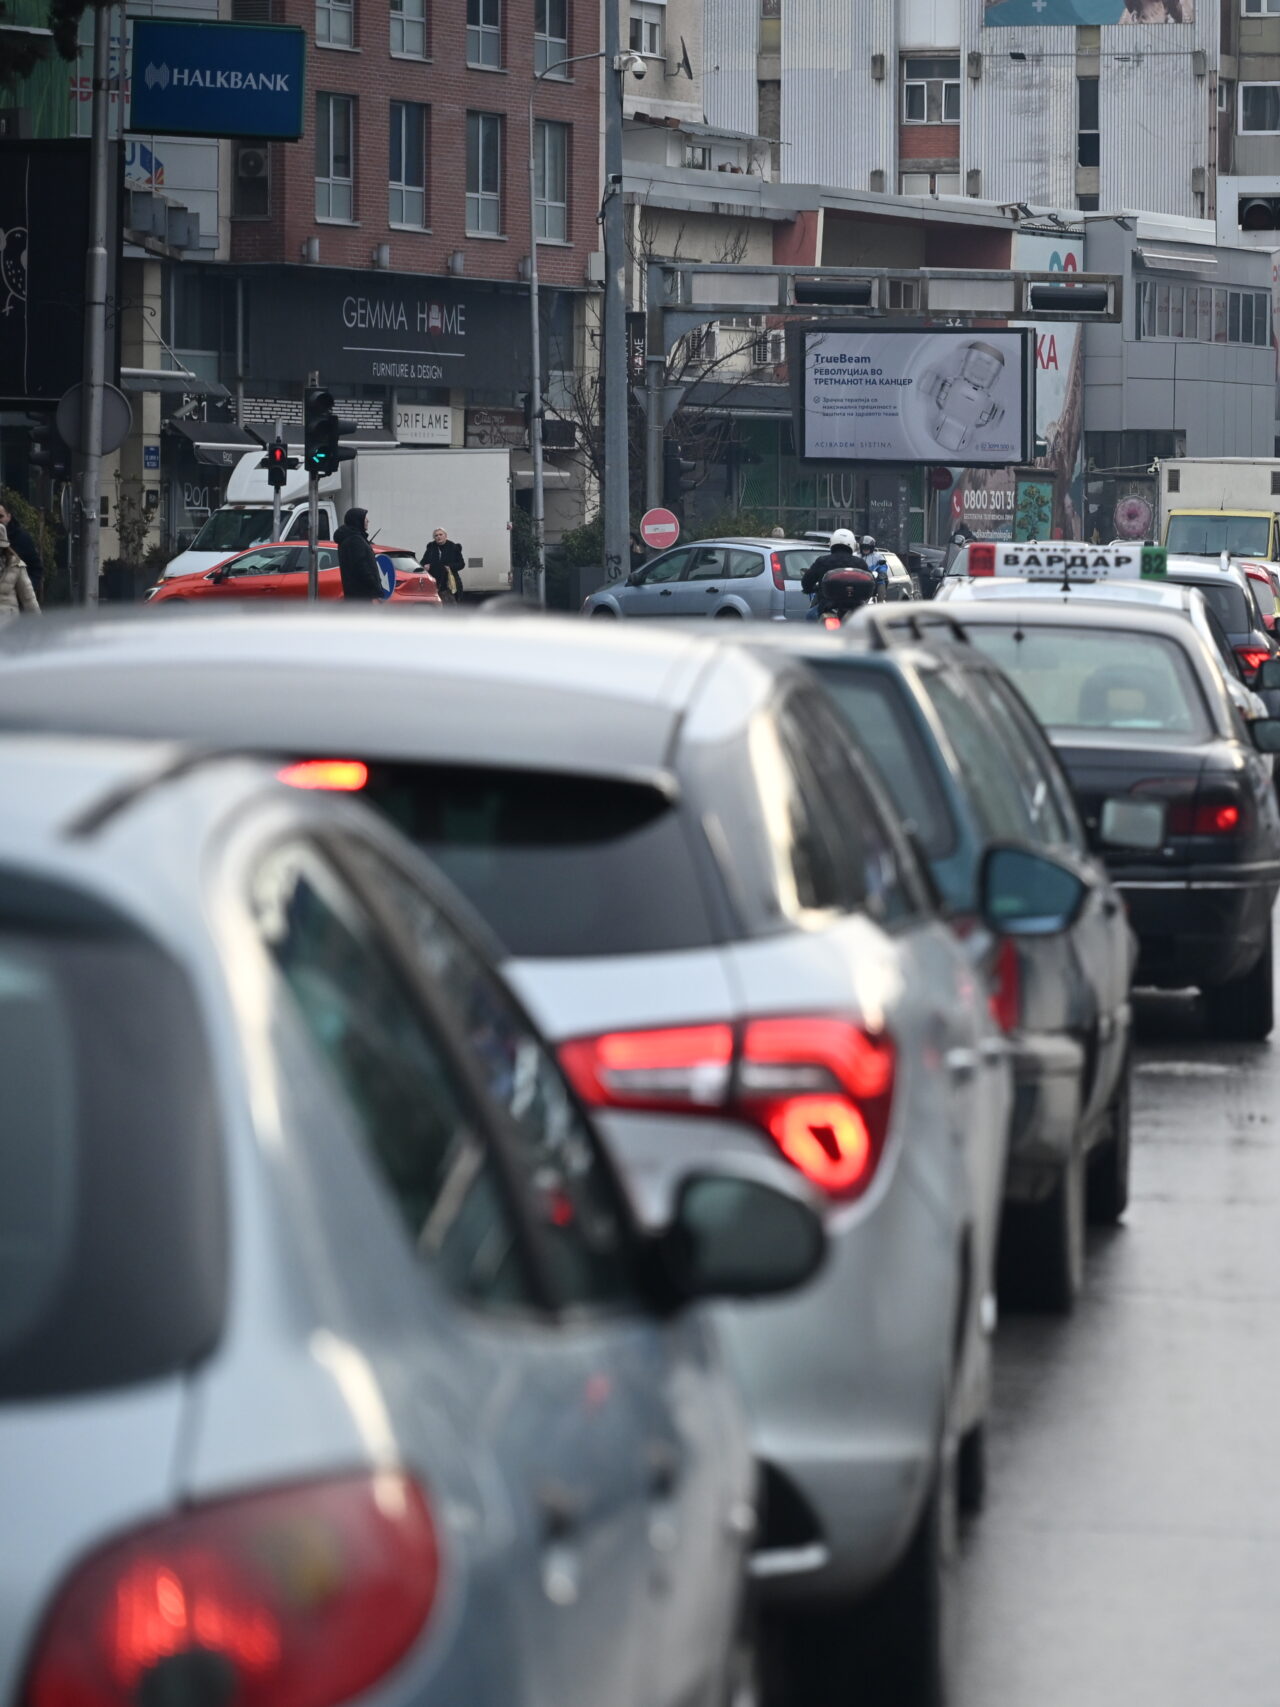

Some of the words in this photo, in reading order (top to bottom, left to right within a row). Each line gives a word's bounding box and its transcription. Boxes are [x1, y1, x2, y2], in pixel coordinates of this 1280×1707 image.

[173, 68, 289, 91] HALKBANK
[343, 296, 408, 331] GEMMA
[814, 353, 871, 364] TrueBeam
[372, 362, 409, 378] FURNITURE
[410, 365, 416, 378] &
[417, 364, 443, 379] DESIGN
[814, 368, 869, 377] РЕВОЛУЦИЈА
[870, 368, 883, 376] ВО
[814, 378, 864, 386] ТРЕТМАНОТ
[865, 378, 878, 386] НА
[879, 378, 913, 387] КАНЦЕР
[963, 489, 988, 510] 0800
[989, 490, 1005, 510] 301
[1003, 554, 1132, 569] ВАРДАР
